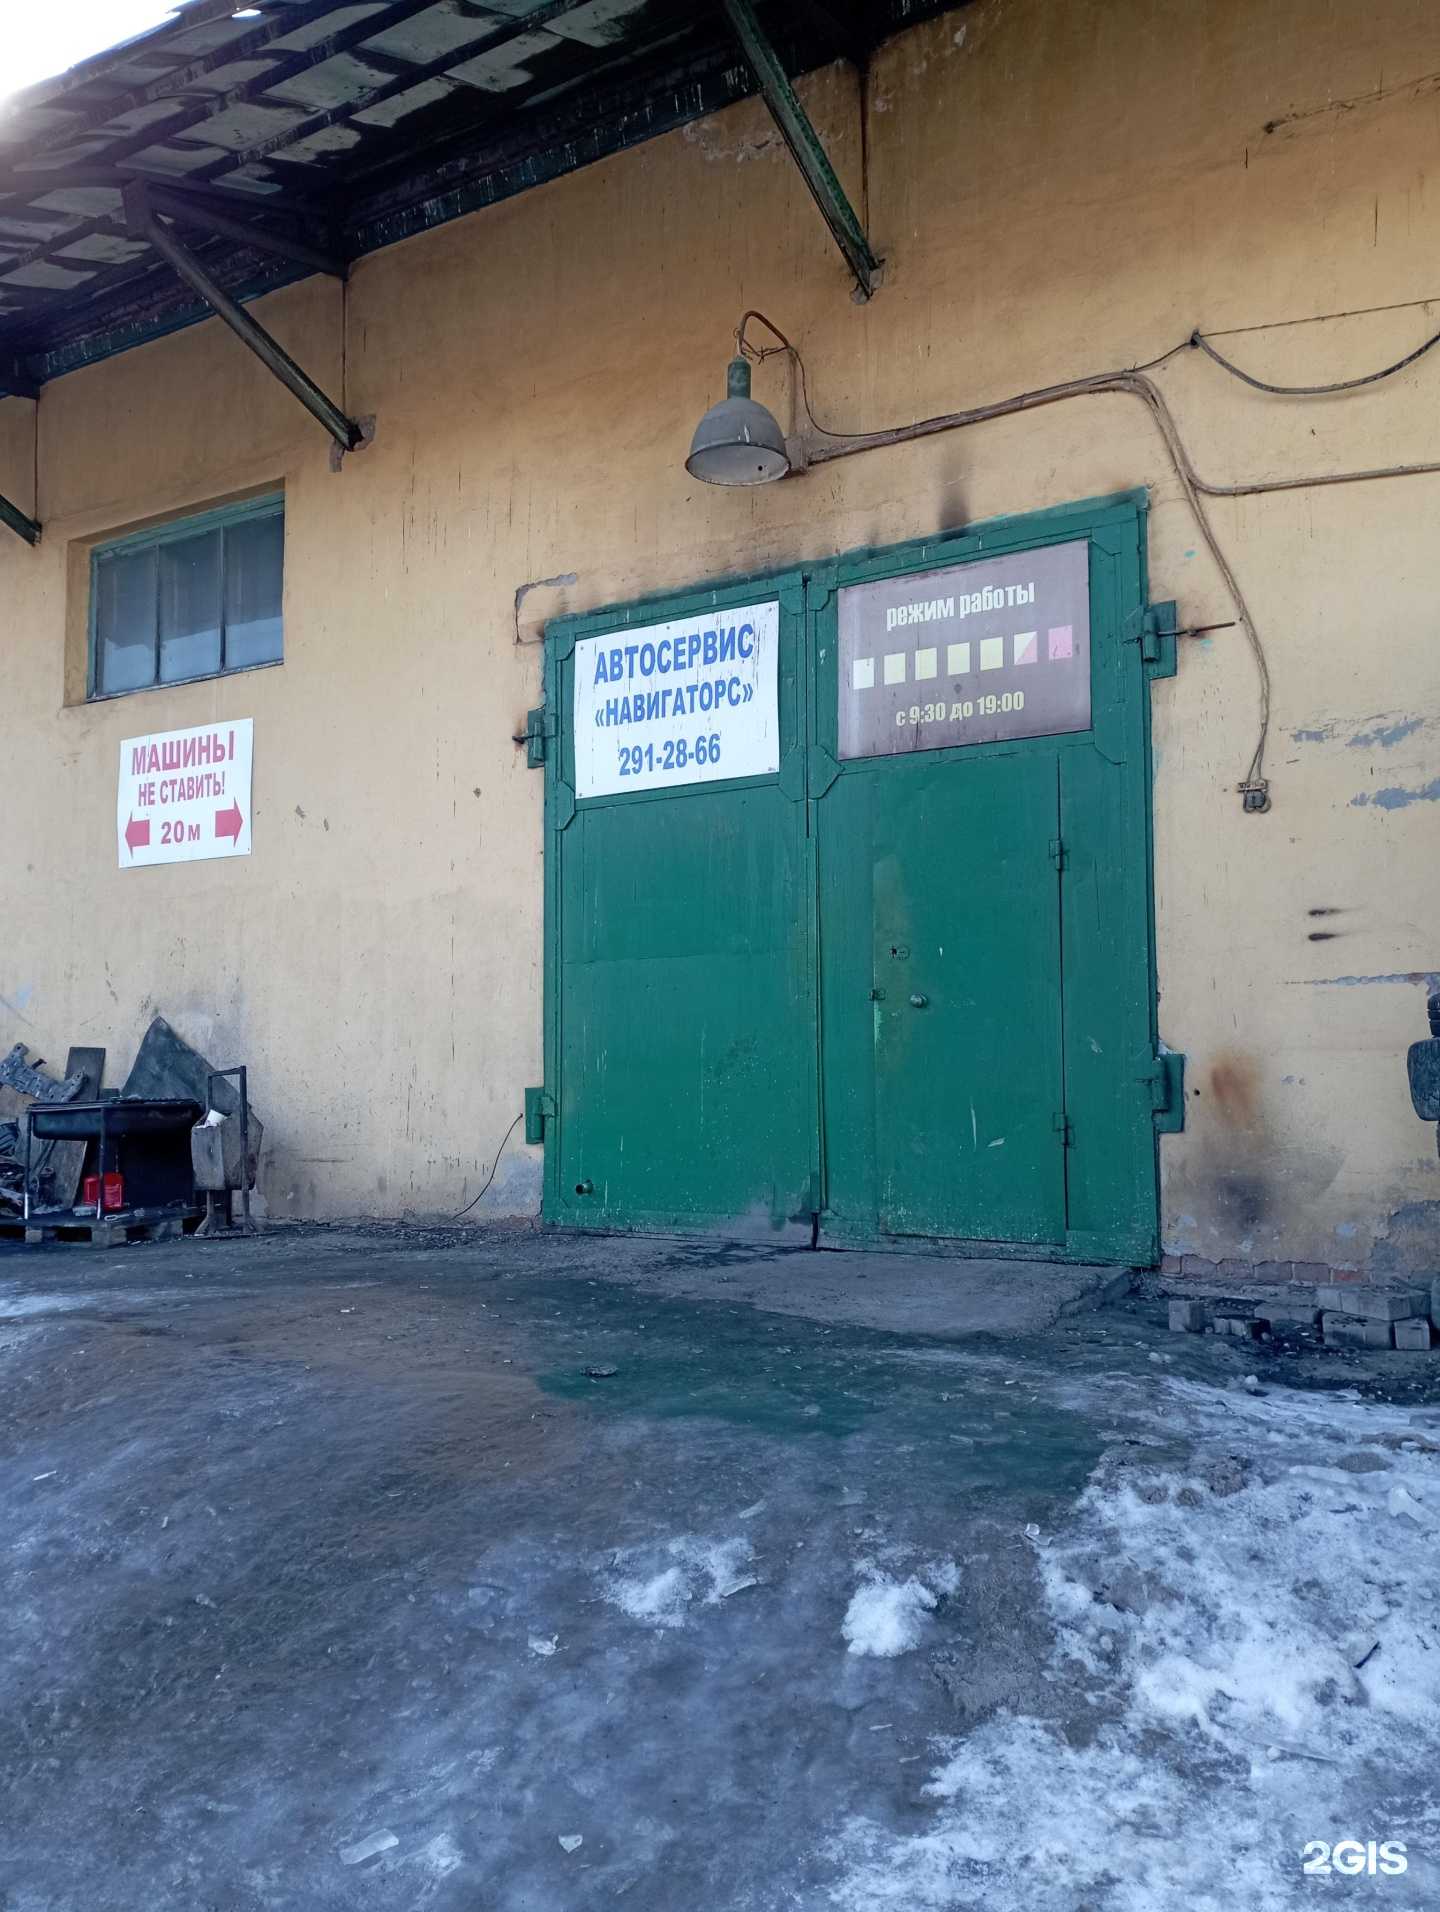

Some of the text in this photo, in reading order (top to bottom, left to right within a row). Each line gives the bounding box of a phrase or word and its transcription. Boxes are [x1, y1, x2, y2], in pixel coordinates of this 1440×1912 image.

[886, 582, 1035, 632] режим работы
[594, 623, 754, 685] АВТОСЕРВИС
[595, 676, 754, 727] «НАВИГАТОРС»
[895, 691, 1025, 727] с 9:30 до 19:00
[131, 730, 235, 776] МАШИНЫ
[618, 733, 721, 776] 291-28-66
[138, 771, 226, 807] НЕ СТАВИТЬ!
[160, 820, 201, 845] 20 м
